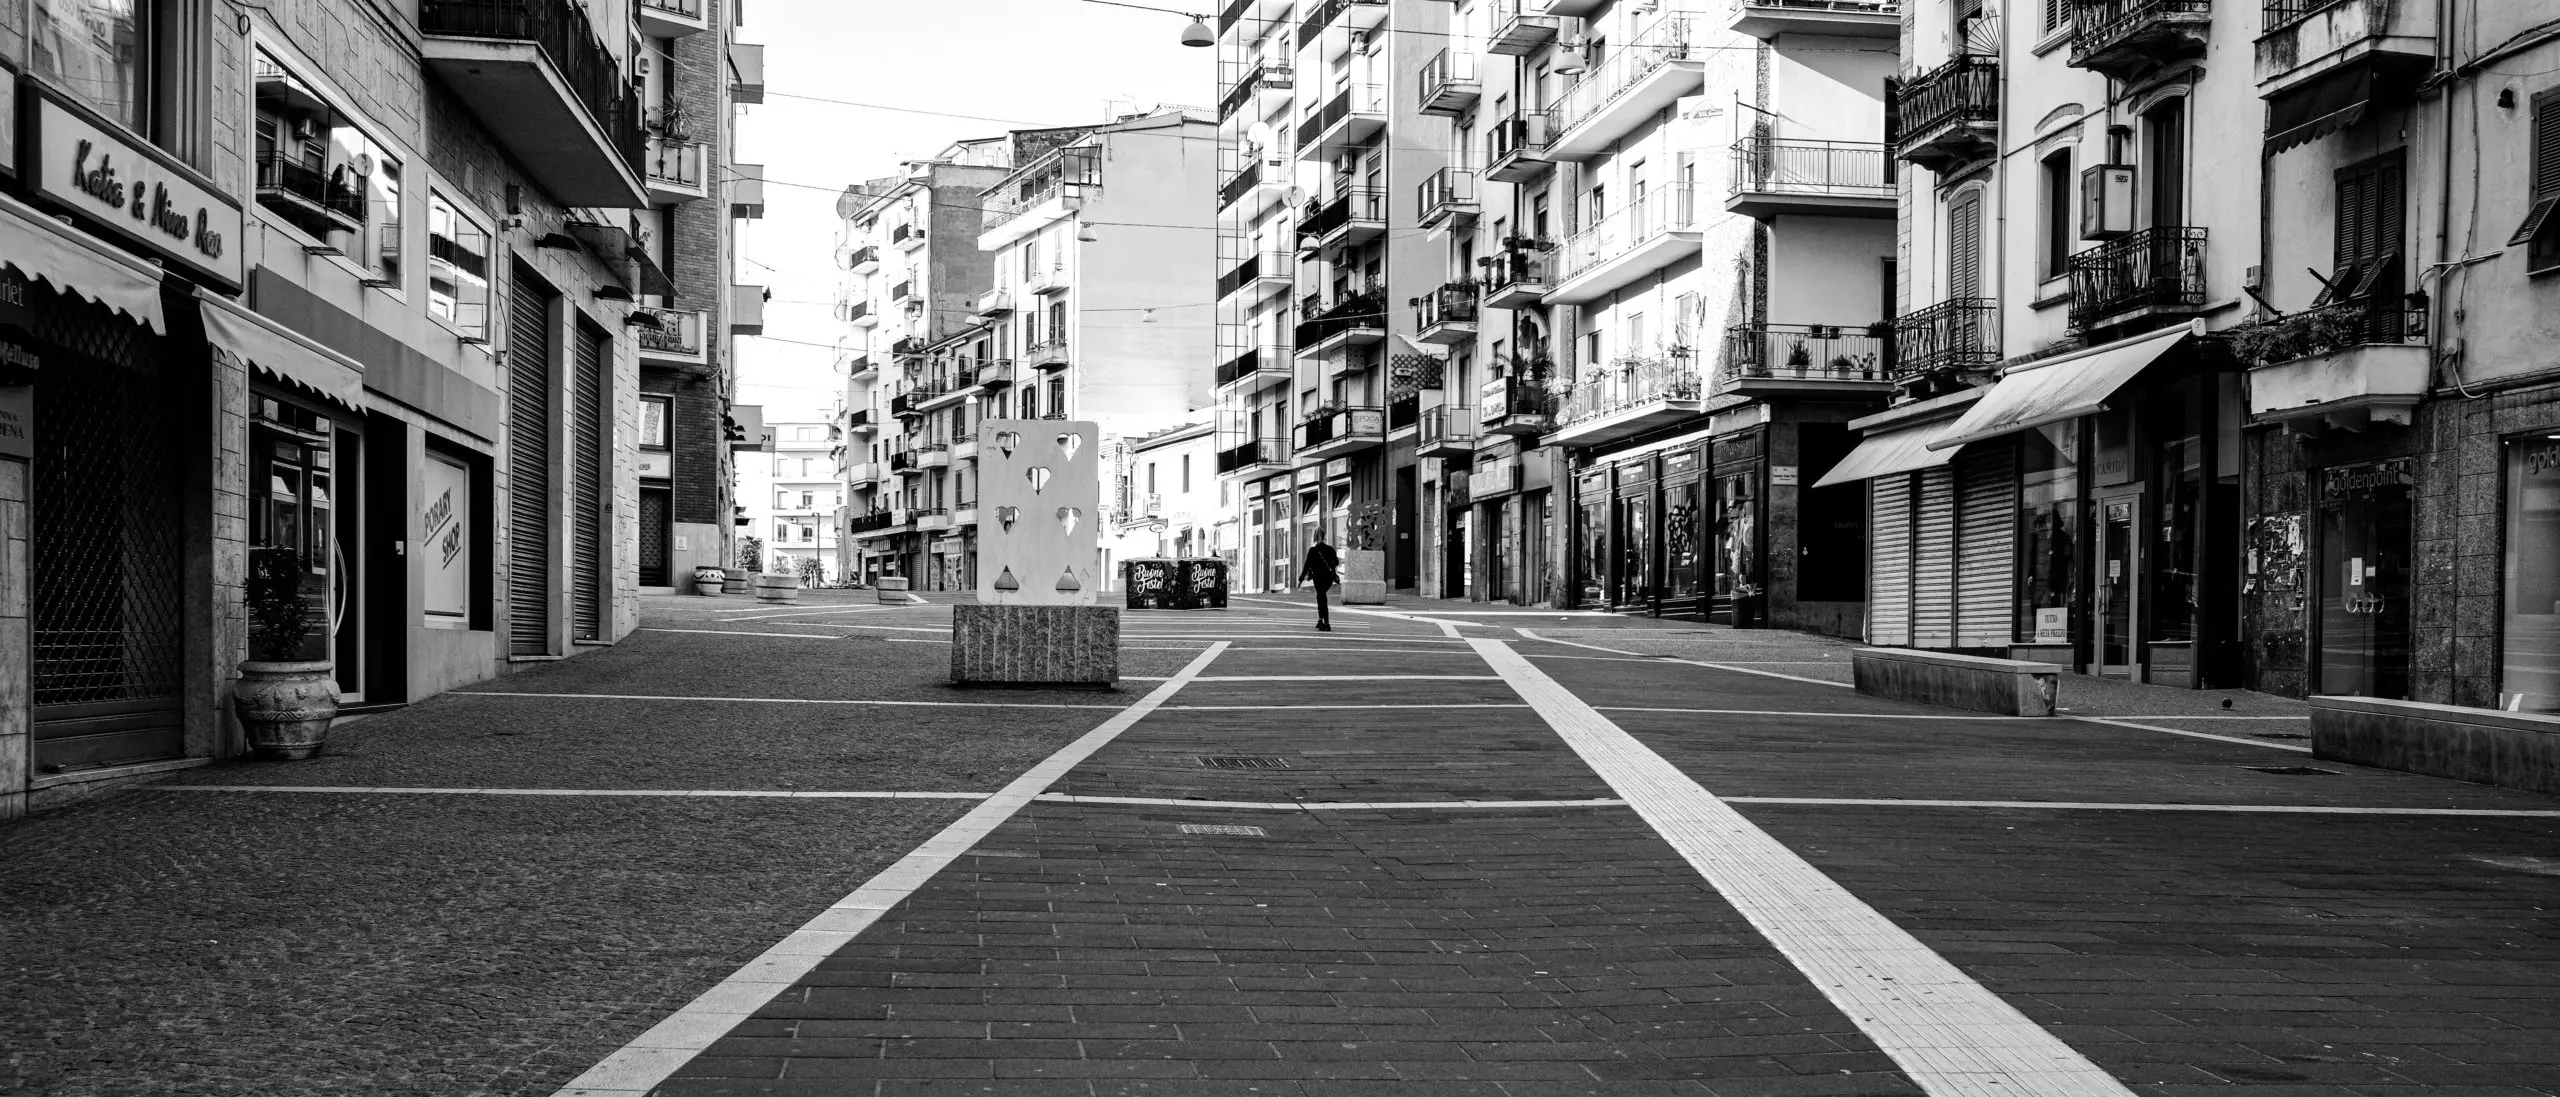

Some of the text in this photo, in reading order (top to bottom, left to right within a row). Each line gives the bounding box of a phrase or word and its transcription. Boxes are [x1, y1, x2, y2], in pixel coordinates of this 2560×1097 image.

[74, 138, 125, 209] Katia
[131, 180, 146, 221] &
[151, 180, 189, 240] Nino
[0, 277, 24, 307] rlet
[2333, 467, 2399, 497] goldenpoint
[442, 521, 460, 563] SHOP
[1134, 564, 1164, 582] Buone
[1191, 564, 1217, 582] Buone
